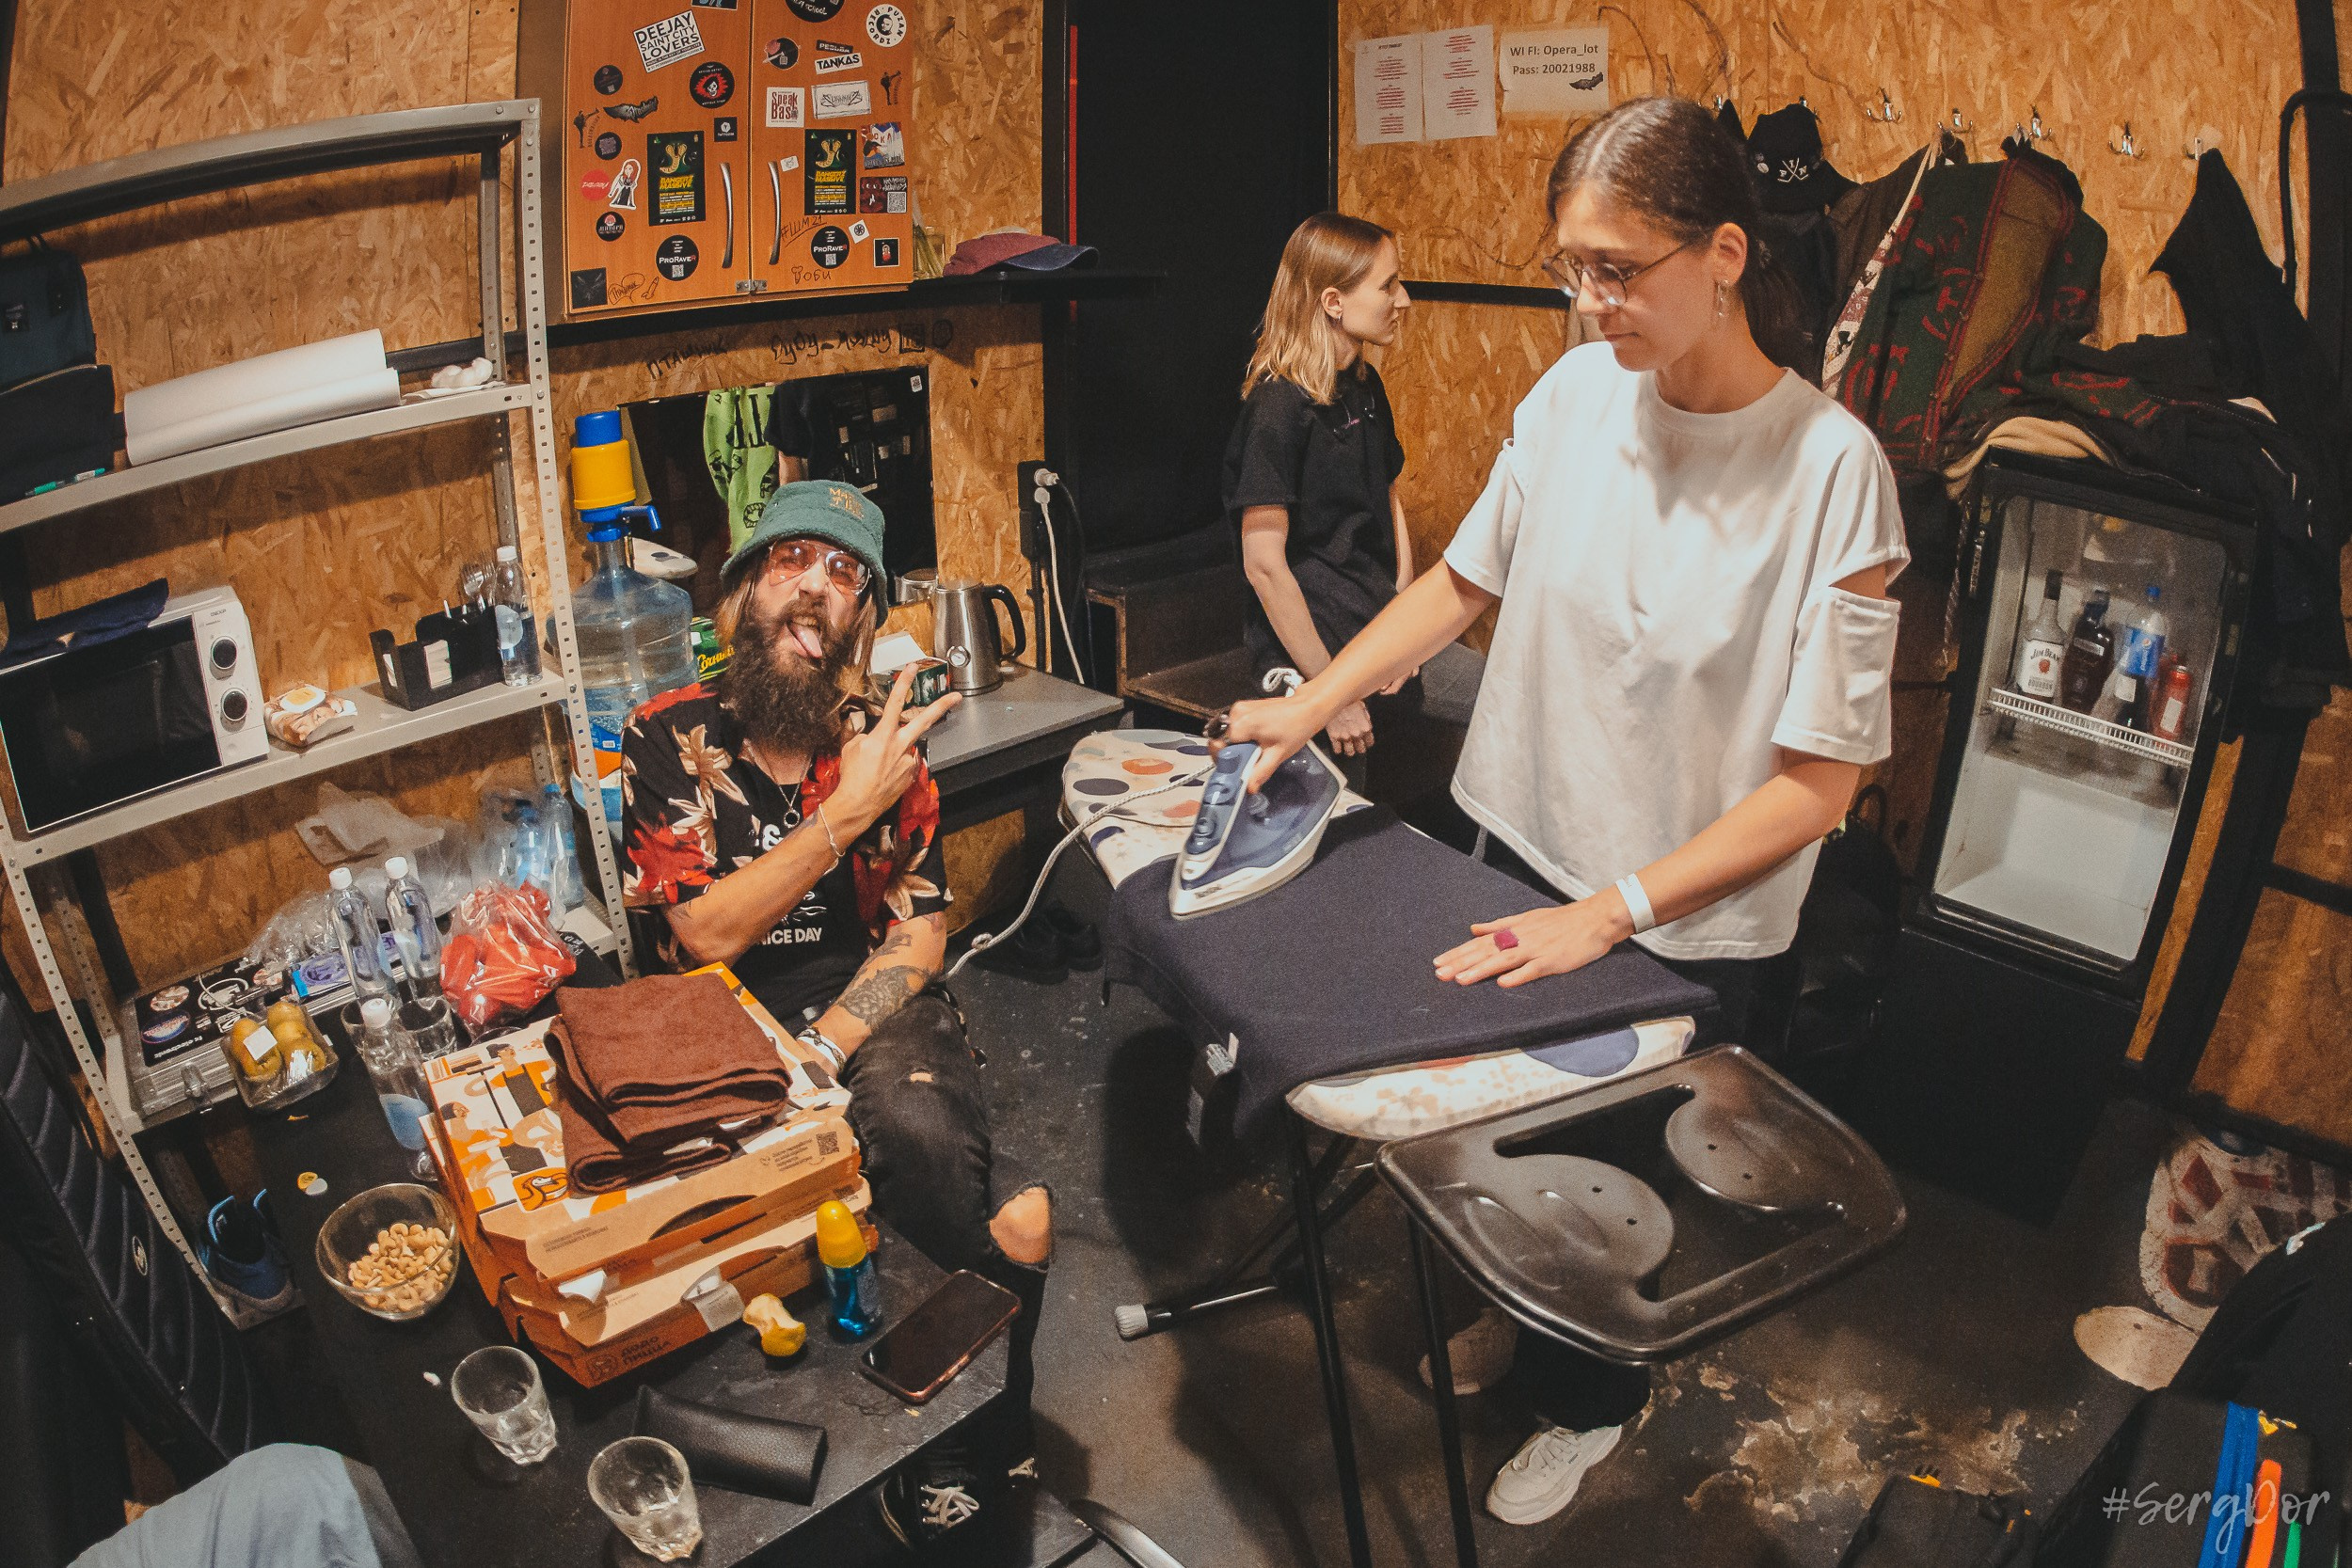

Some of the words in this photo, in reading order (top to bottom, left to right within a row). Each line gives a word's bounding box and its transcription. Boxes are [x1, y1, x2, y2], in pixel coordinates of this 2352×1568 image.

[635, 12, 691, 44] DEEJAY
[641, 34, 670, 52] SAINT
[673, 24, 694, 39] CITY
[643, 33, 699, 61] LOVERS
[1510, 46, 1524, 56] WI
[1528, 45, 1540, 55] FI:
[1543, 43, 1598, 56] Opera_lot
[817, 55, 860, 70] TANKAS
[1513, 65, 1539, 75] Pass:
[1542, 63, 1596, 74] 20021988
[771, 91, 798, 108] Speak
[762, 928, 793, 945] ICE
[794, 927, 822, 943] DAY
